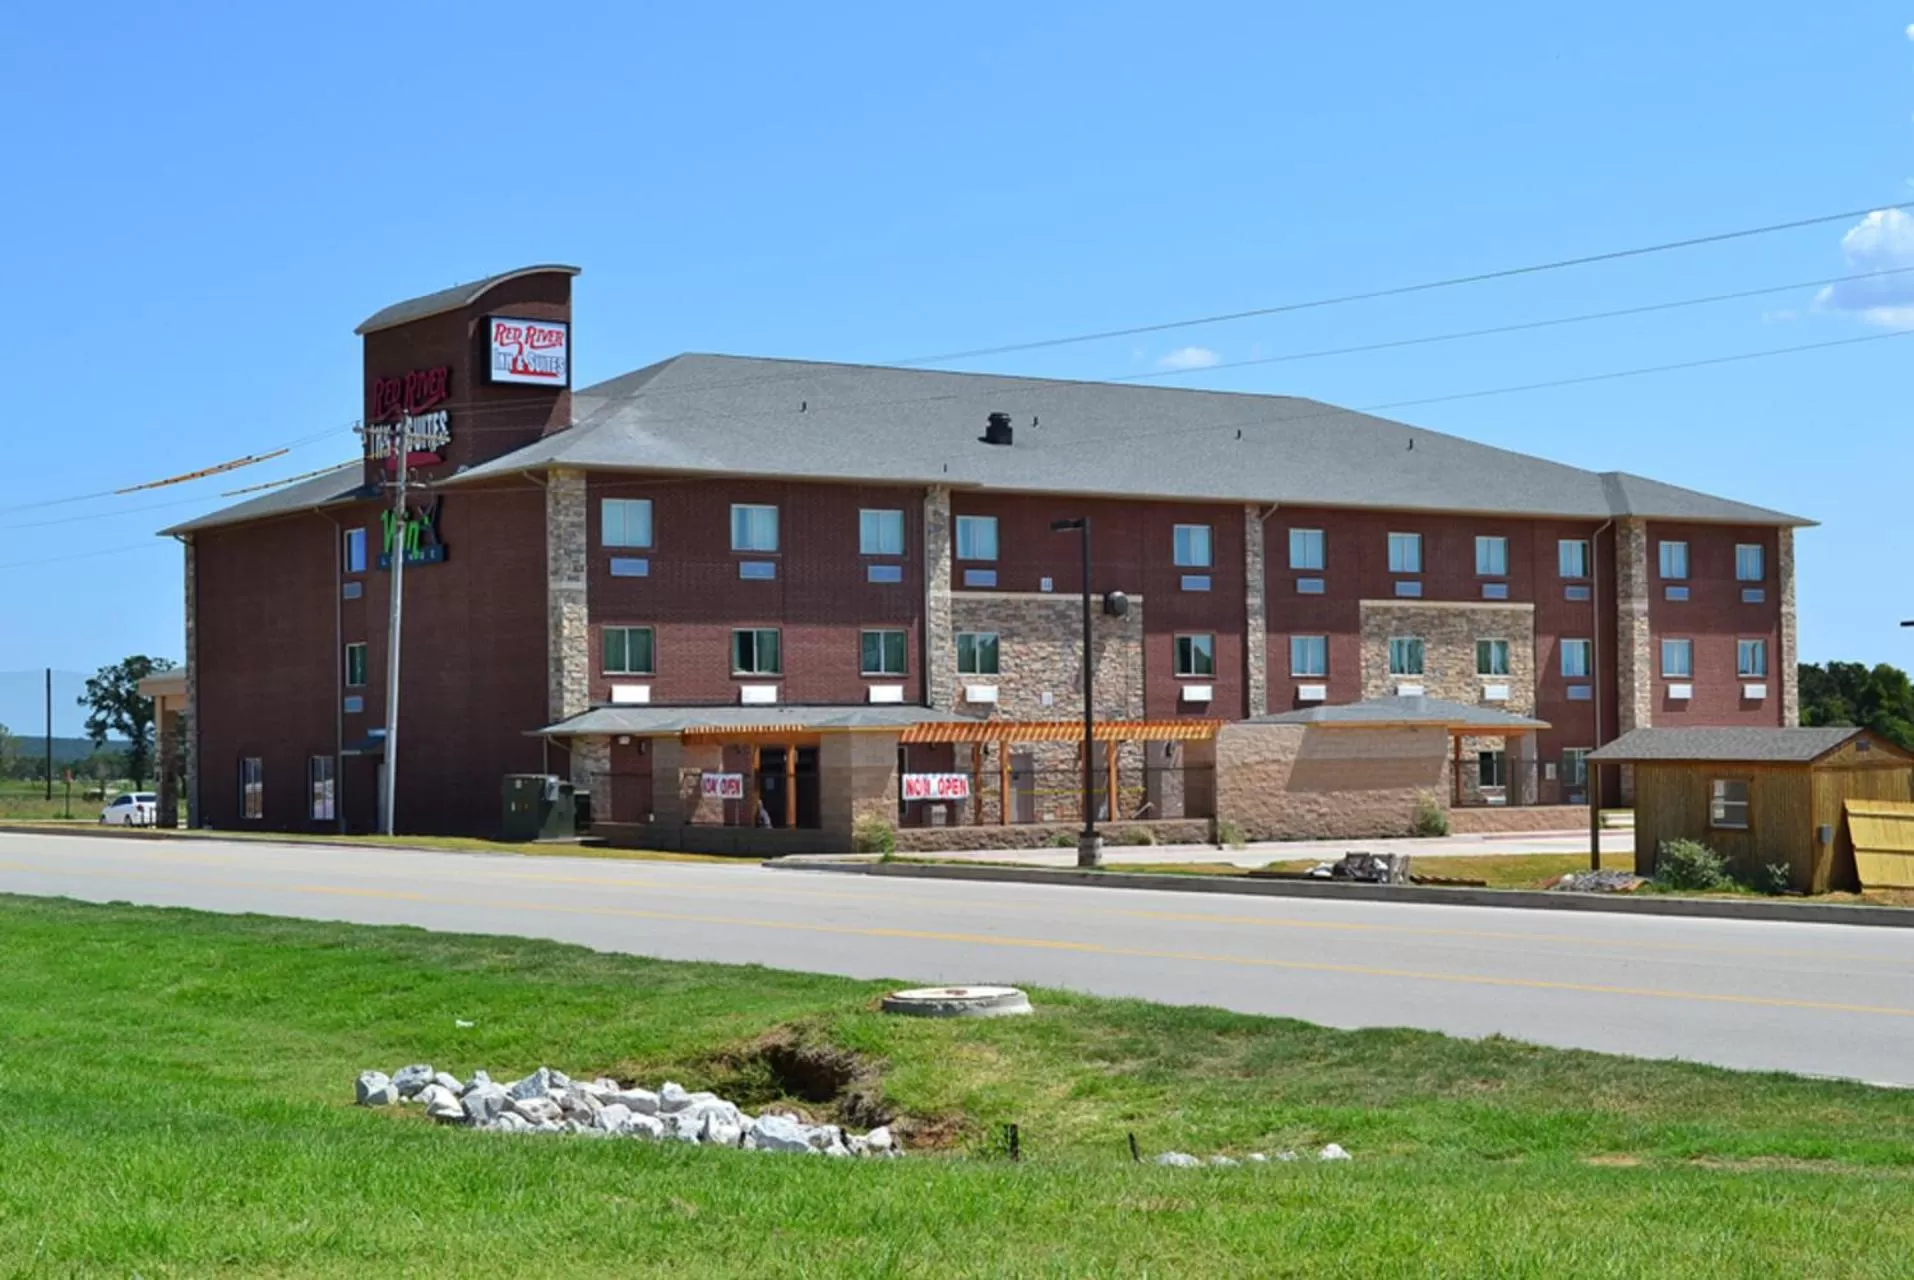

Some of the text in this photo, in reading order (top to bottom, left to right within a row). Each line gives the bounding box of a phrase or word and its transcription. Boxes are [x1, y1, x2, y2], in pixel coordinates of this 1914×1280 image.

[494, 323, 565, 349] RED RIVER
[526, 351, 566, 374] SUITES
[373, 366, 447, 420] RED RIVER
[404, 410, 449, 453] SUITES
[720, 777, 741, 796] OPEN
[905, 777, 967, 797] NOW OPEN
